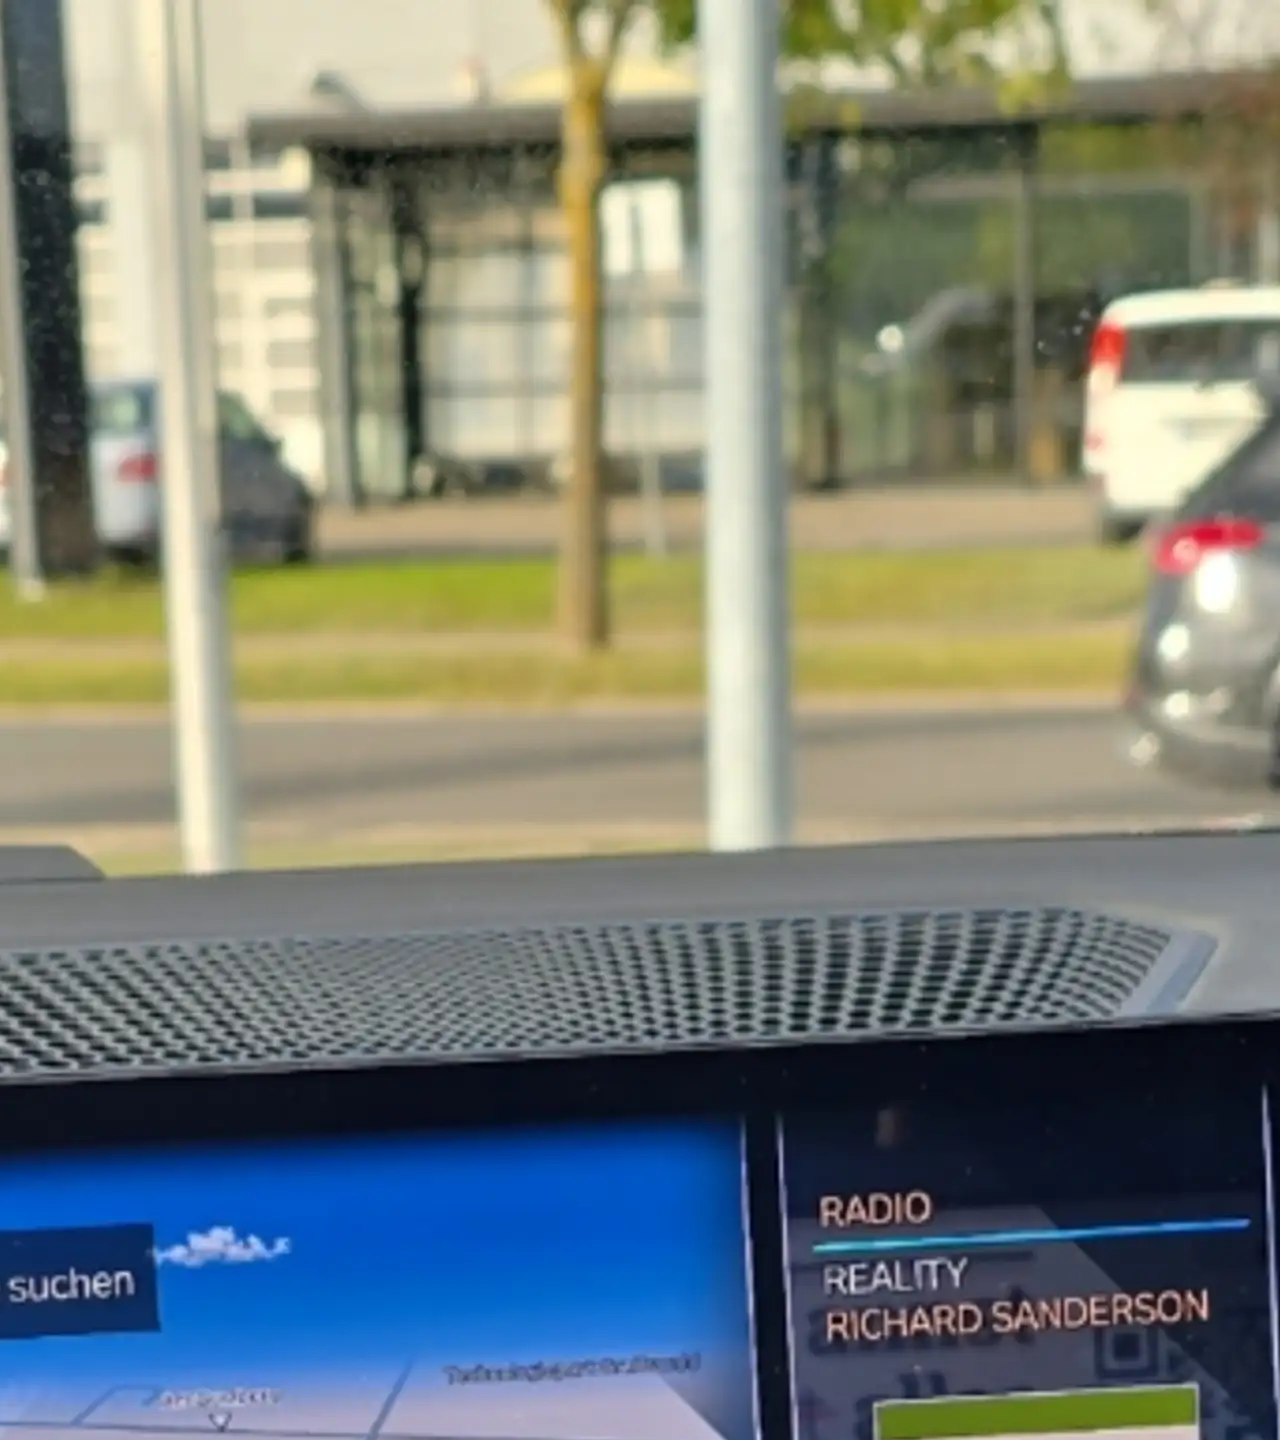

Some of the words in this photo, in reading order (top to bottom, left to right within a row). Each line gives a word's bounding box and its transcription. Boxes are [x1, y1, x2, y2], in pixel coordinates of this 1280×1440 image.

[820, 1190, 932, 1228] RADIO
[7, 1265, 136, 1304] suchen
[824, 1257, 968, 1295] REALITY
[827, 1302, 982, 1343] RICHARD
[991, 1288, 1210, 1333] SANDERSON
